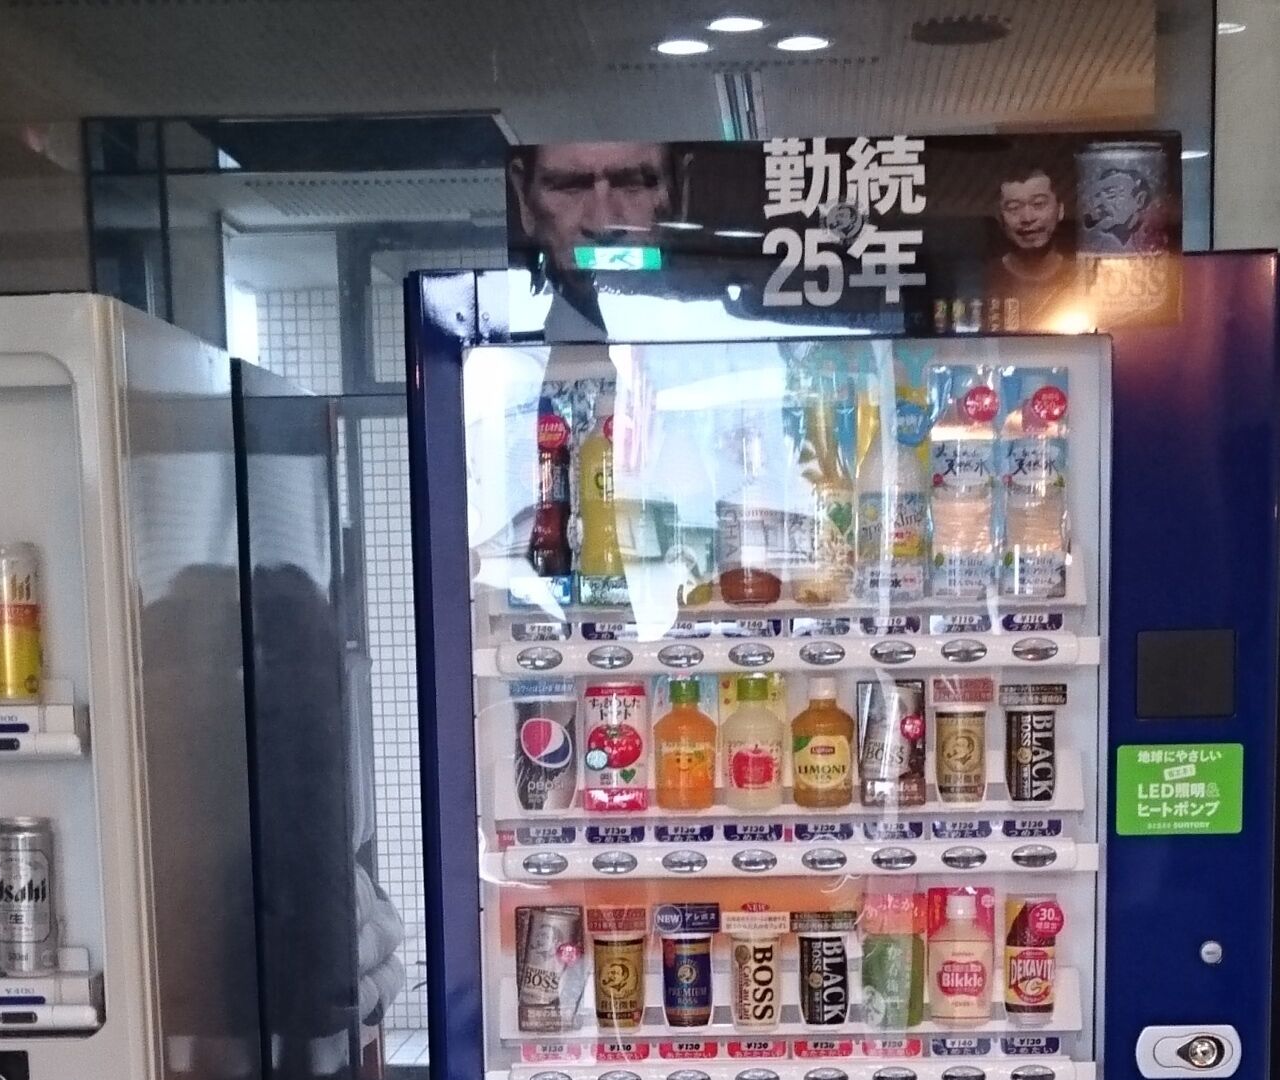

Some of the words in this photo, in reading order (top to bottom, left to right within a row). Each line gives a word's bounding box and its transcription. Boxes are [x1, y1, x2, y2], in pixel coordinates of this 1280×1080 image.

[763, 136, 926, 219] 勤続
[763, 224, 926, 307] 25年
[1021, 715, 1032, 747] BOSS
[1032, 715, 1054, 799] BLACK
[1137, 750, 1222, 763] 地球にやさしい
[1137, 801, 1220, 818] ヒートポンプ
[657, 914, 680, 924] NEW
[811, 942, 822, 972] BOSS
[526, 973, 559, 990] BOSS
[752, 945, 774, 1020] BOSS
[823, 941, 846, 1022] BLACK
